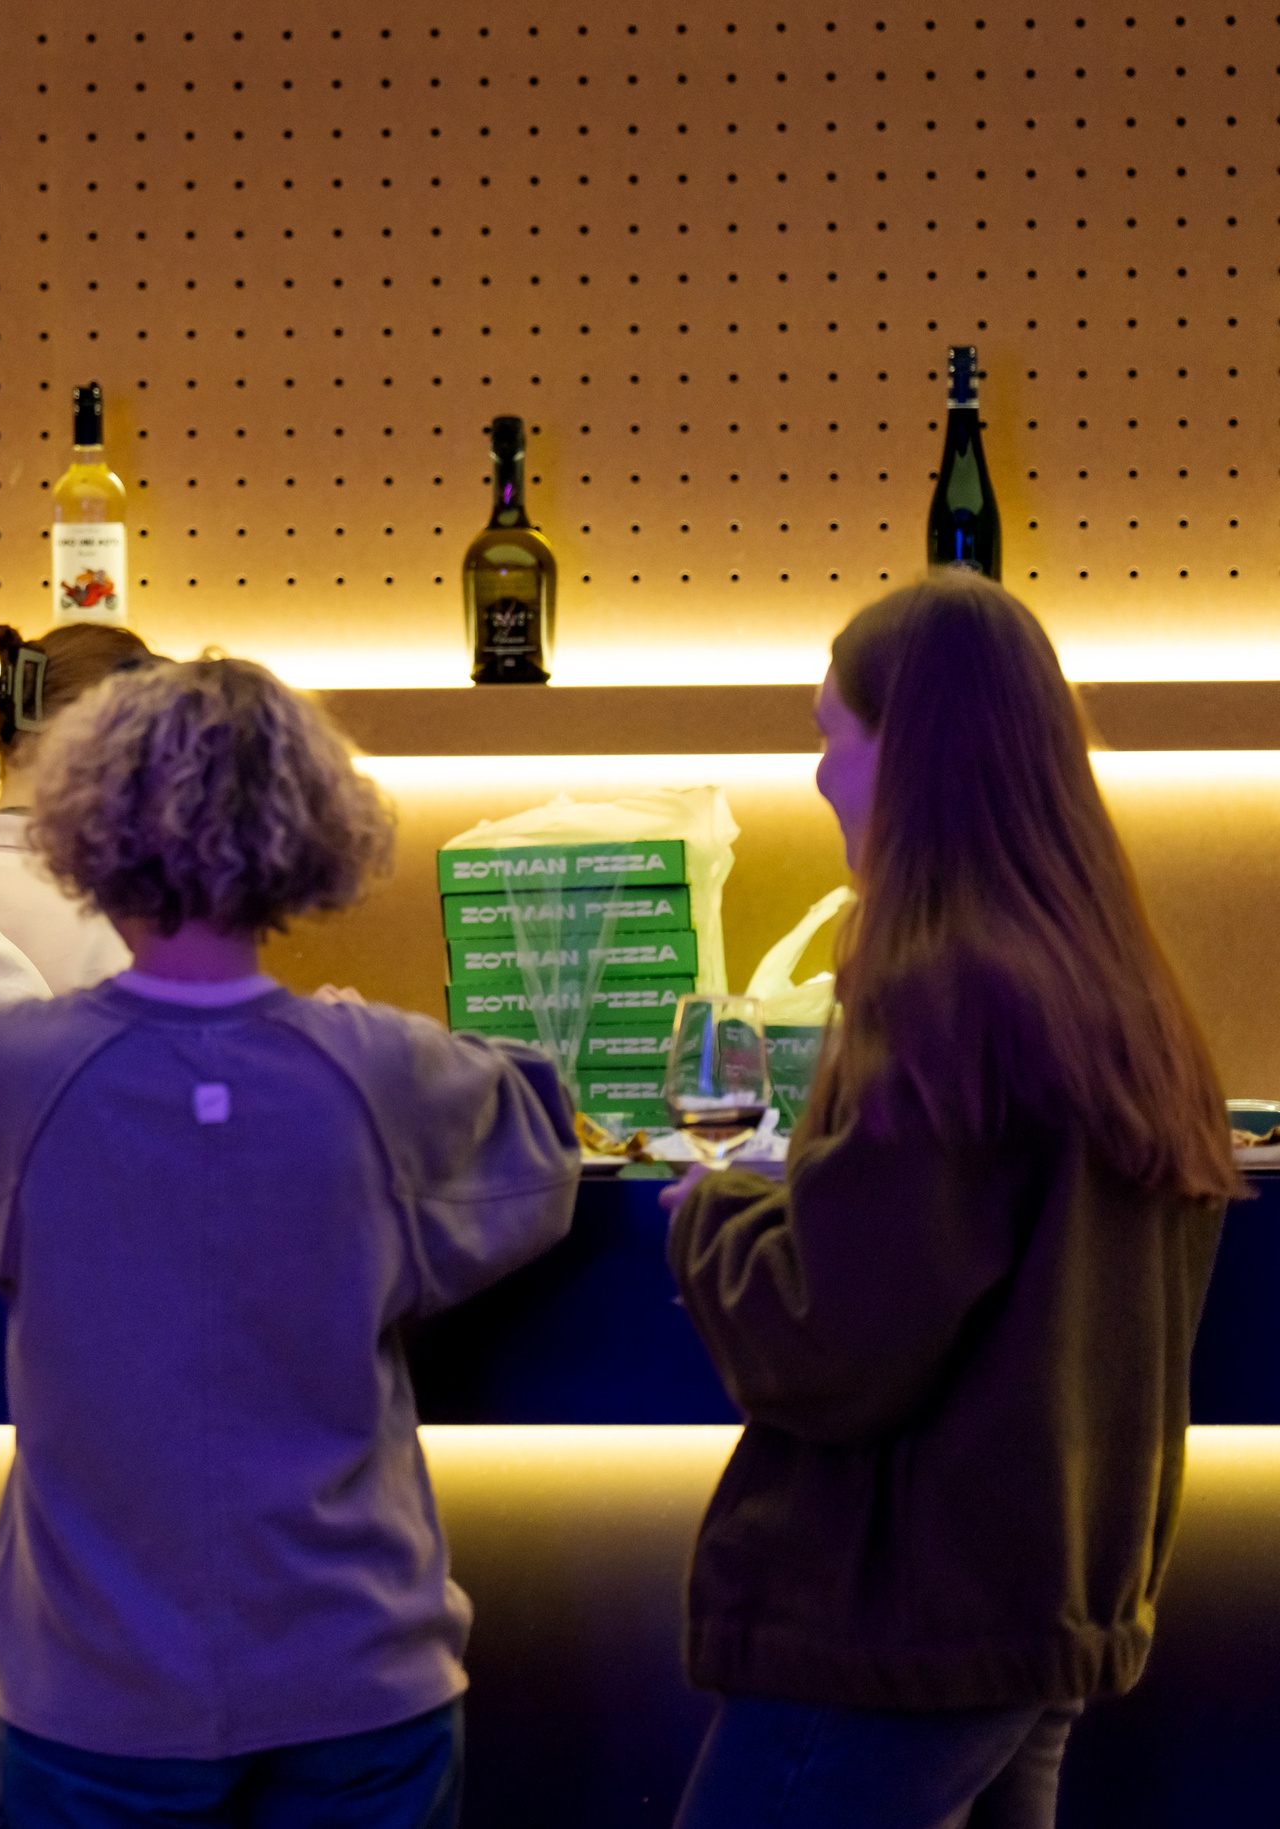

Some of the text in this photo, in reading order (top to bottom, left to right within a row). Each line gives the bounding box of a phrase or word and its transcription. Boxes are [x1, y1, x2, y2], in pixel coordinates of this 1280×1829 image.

[453, 854, 666, 879] ZOTMAN PIZZA
[461, 899, 675, 924] ZOTMAN PIZZA
[464, 945, 678, 970] ZOTMAN PIZZA
[466, 990, 678, 1013] ZOTMAN PIZZA
[590, 1082, 665, 1100] PIZZ
